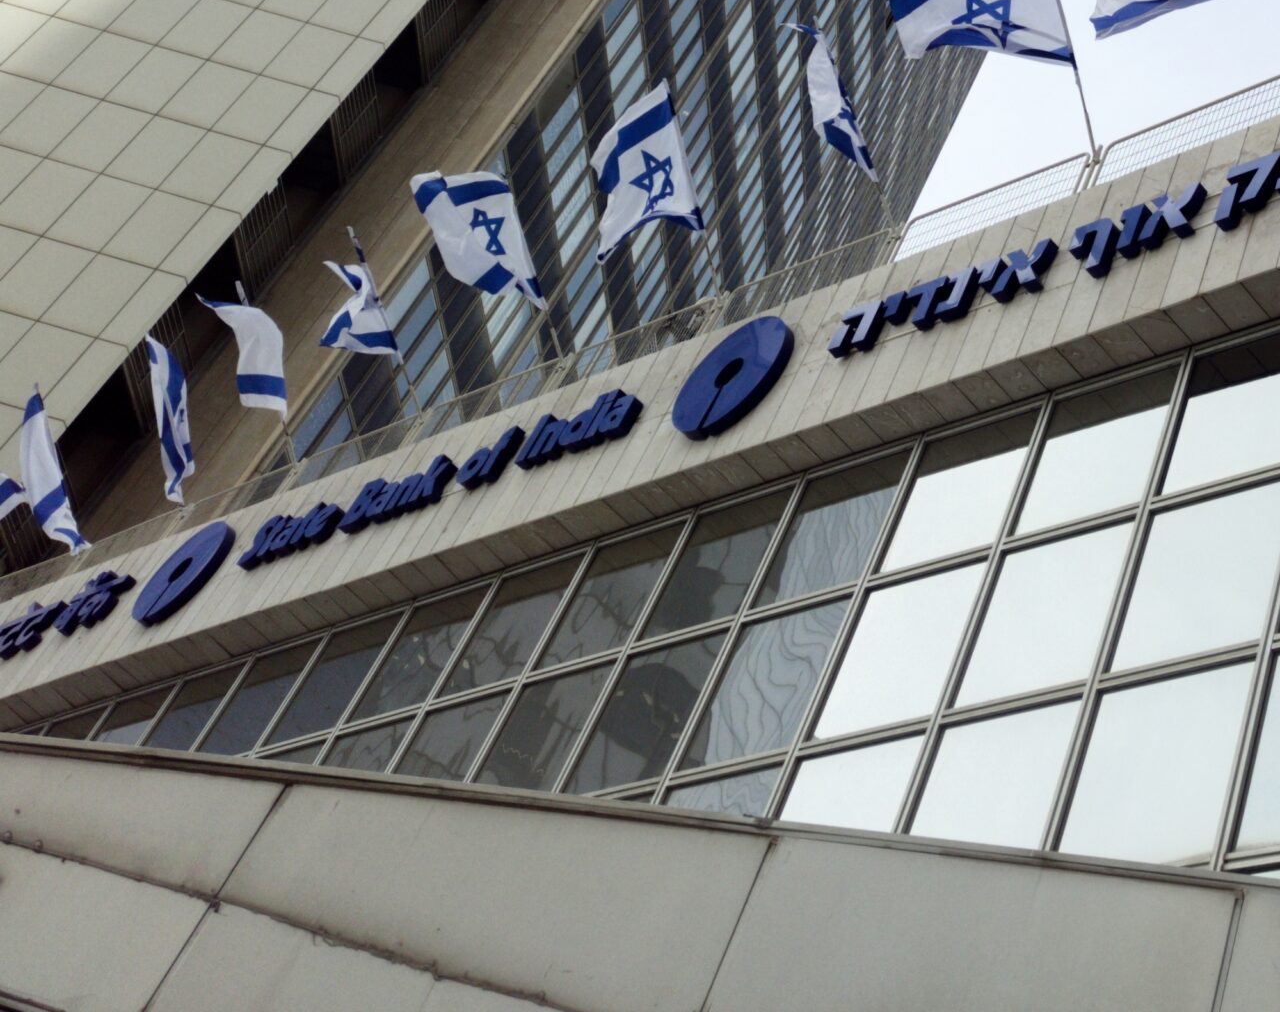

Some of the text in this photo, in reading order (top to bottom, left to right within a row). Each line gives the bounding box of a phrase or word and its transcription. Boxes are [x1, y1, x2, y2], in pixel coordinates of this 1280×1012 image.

[1068, 182, 1208, 278] אוף
[827, 238, 1059, 358] אינדיה
[236, 389, 644, 571] State Bank of India
